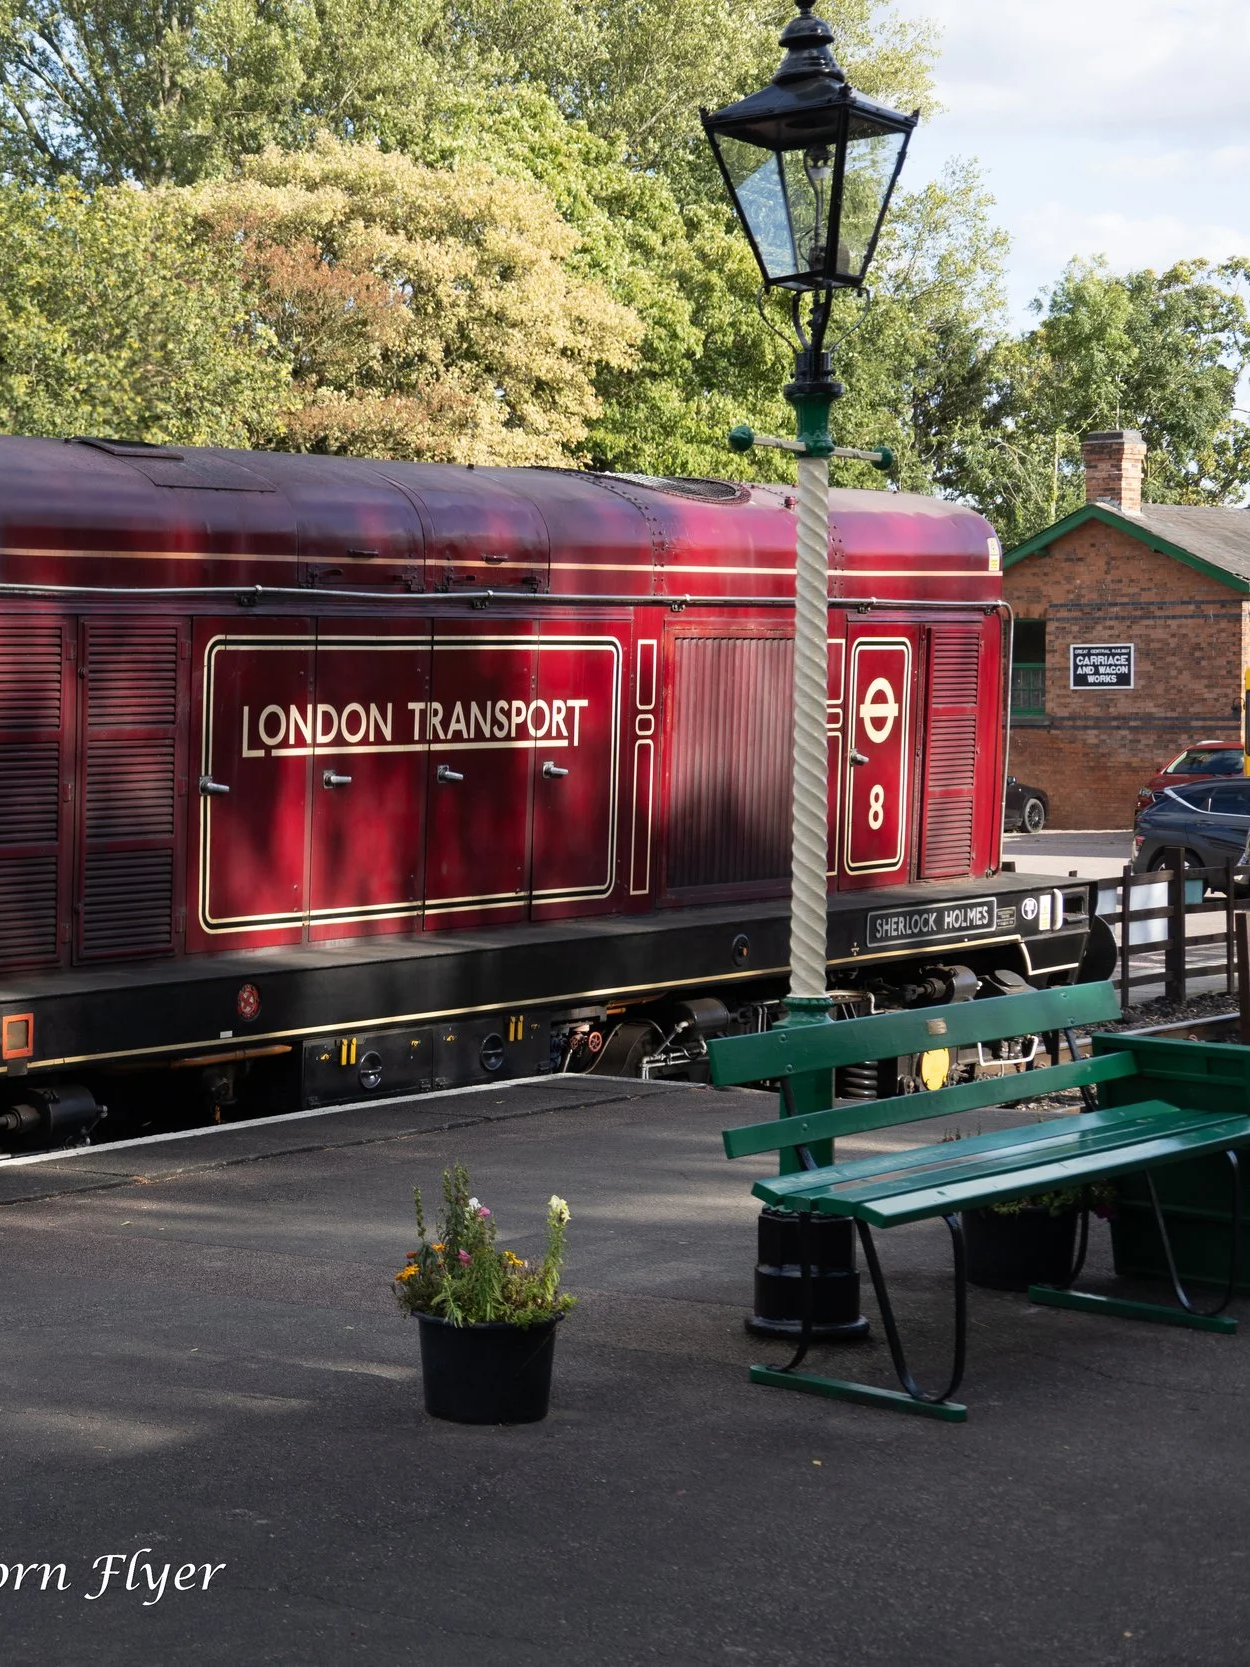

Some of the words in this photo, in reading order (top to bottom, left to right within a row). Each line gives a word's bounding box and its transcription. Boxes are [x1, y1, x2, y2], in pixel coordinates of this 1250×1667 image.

[1076, 656, 1128, 665] CARRIAGE
[1076, 666, 1094, 674] AND
[1088, 674, 1117, 683] WORKS
[242, 702, 392, 757] LONDON
[408, 699, 589, 746] TRANSPORT
[868, 784, 884, 830] 8
[876, 913, 937, 938] SHERLOCK
[944, 906, 988, 930] HOLMES
